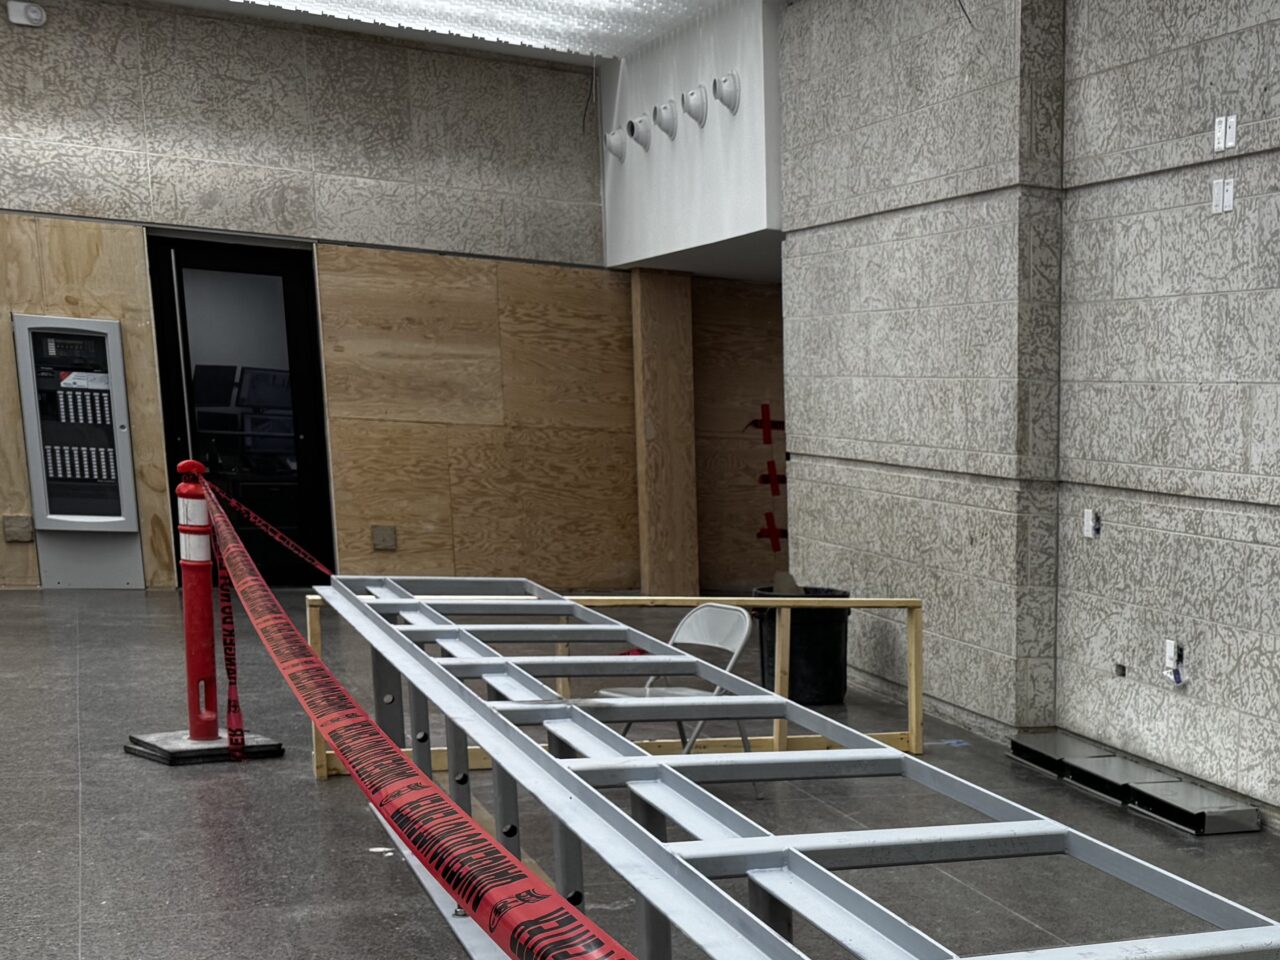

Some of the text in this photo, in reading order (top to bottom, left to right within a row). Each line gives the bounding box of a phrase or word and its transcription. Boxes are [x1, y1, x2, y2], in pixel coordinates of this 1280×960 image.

[390, 792, 458, 837] ENTER
[408, 816, 475, 857] NOT
[428, 832, 488, 871] DO
[440, 843, 528, 911] DANGER
